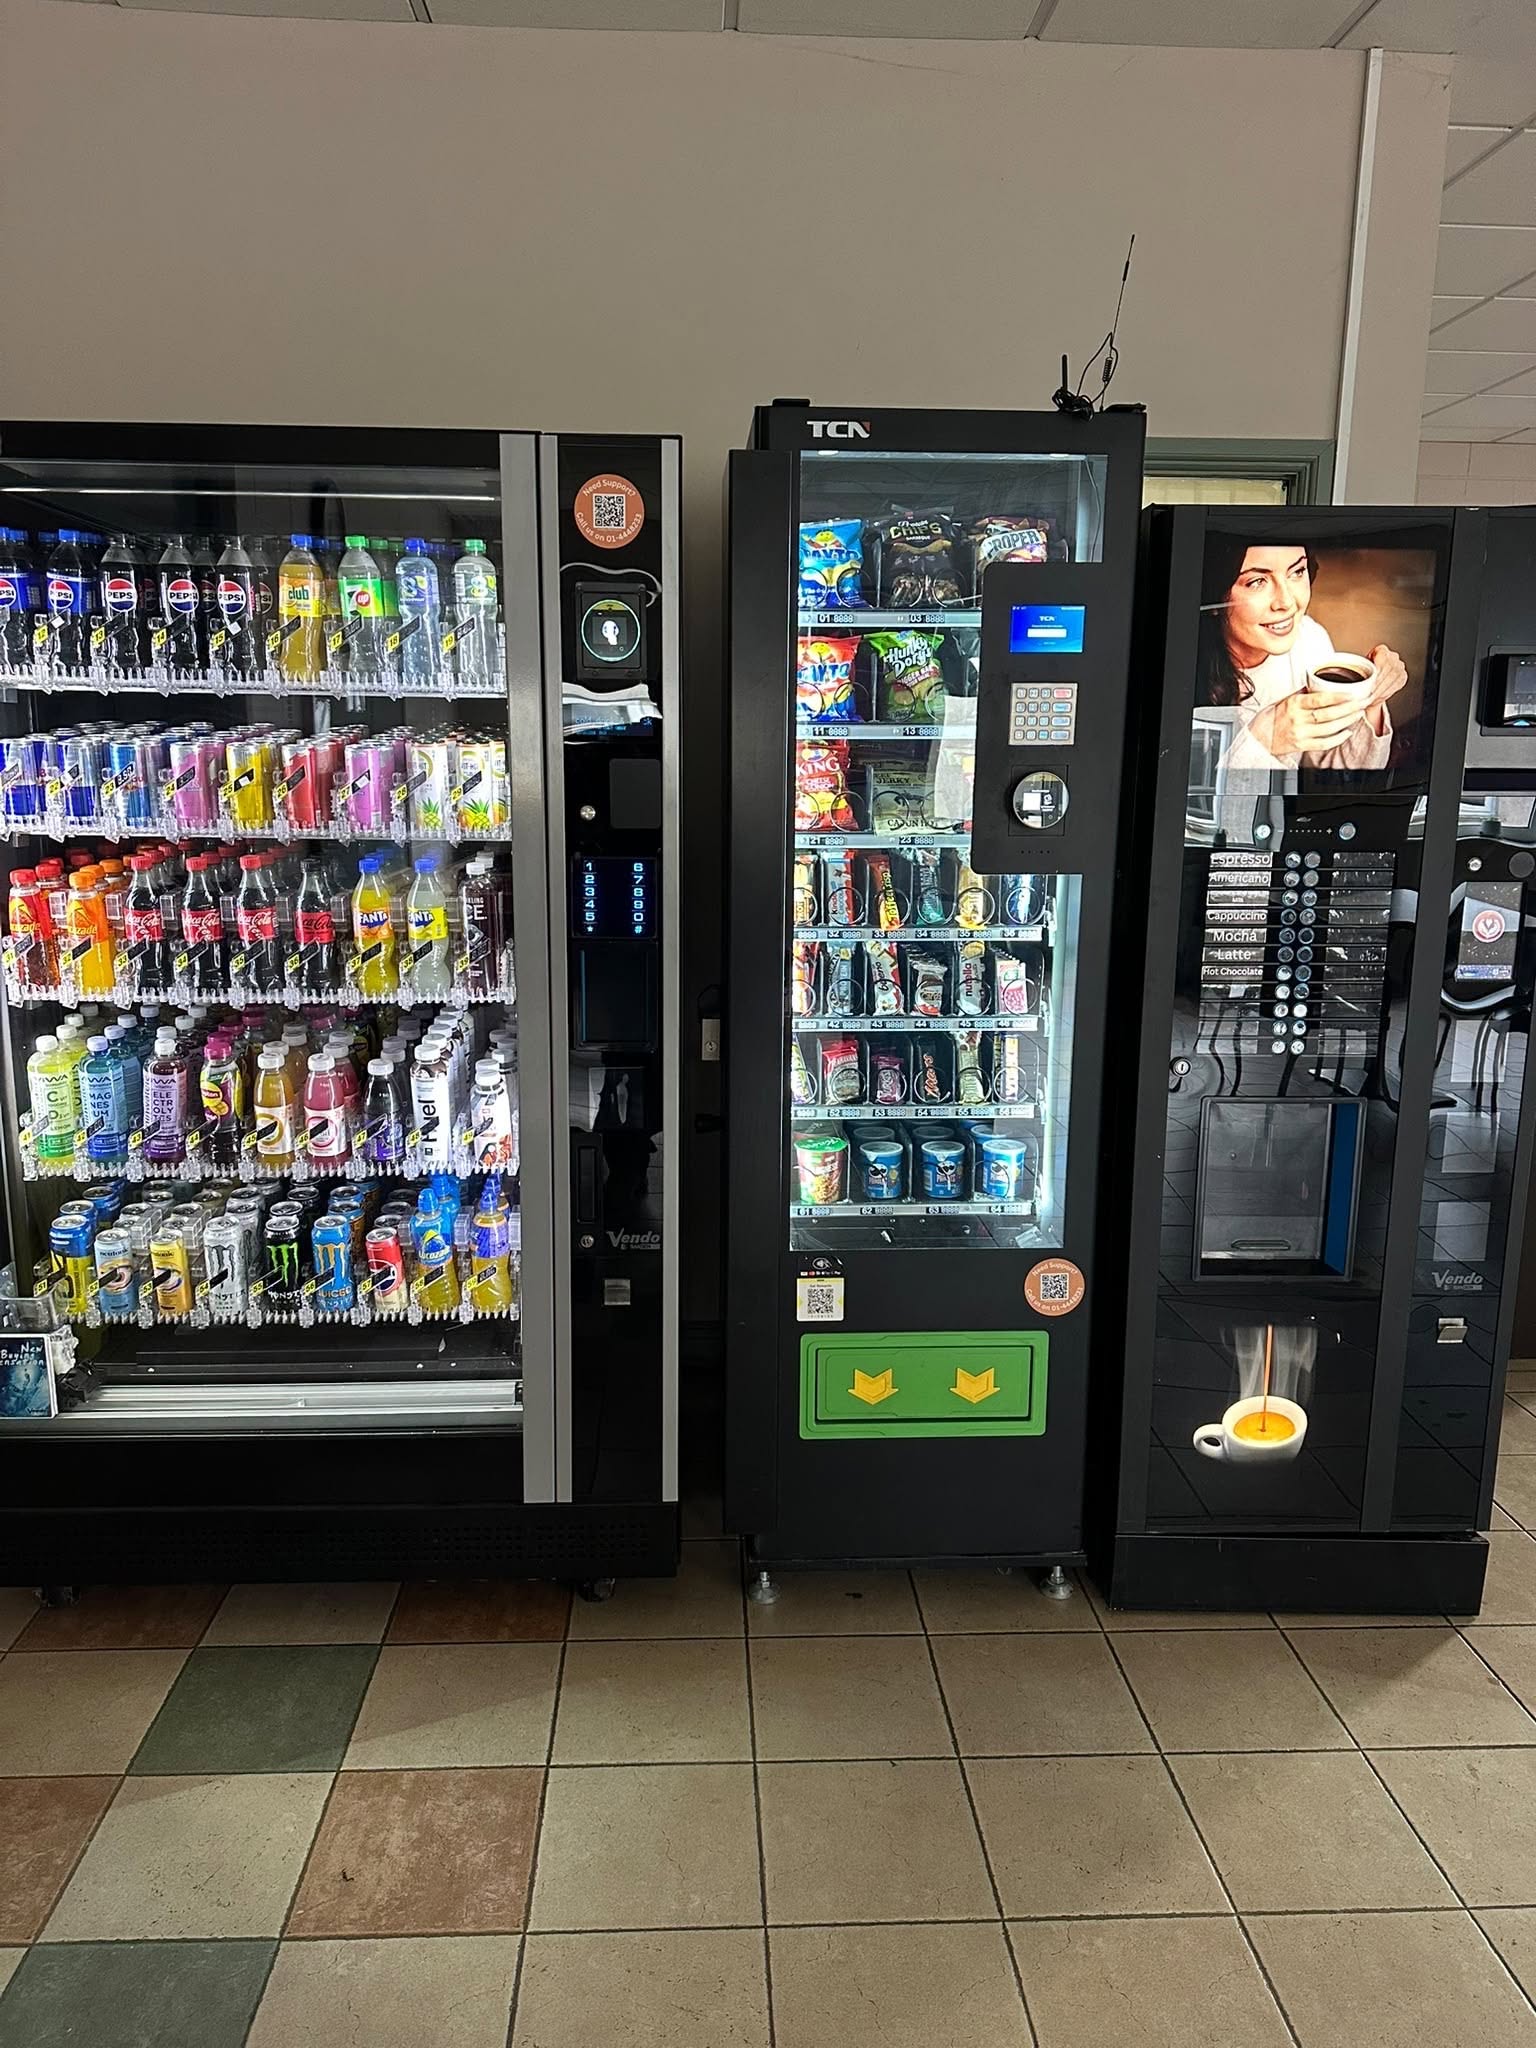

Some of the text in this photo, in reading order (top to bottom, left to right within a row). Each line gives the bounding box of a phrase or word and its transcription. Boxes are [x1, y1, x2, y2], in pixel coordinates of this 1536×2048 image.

[807, 421, 870, 438] TCN
[582, 479, 636, 497] Need Support?
[576, 512, 587, 529] Call
[586, 527, 595, 537] us
[595, 534, 605, 542] on
[890, 522, 942, 539] CHIPS
[50, 590, 72, 599] PPSI
[107, 591, 134, 600] PEPS
[169, 592, 198, 600] PEPSI
[218, 594, 244, 602] PEPSI
[289, 588, 309, 600] club
[357, 594, 369, 604] up
[819, 615, 830, 623] 01
[886, 637, 928, 662] Hunky
[815, 728, 825, 736] 11
[796, 757, 840, 777] KING
[1211, 854, 1270, 866] Espresso
[586, 862, 592, 871] 1
[634, 863, 643, 872] 6
[585, 875, 595, 884] 2
[633, 875, 643, 884] 7
[1209, 873, 1269, 884] Americano
[585, 888, 595, 896] 3
[634, 888, 643, 897] 8
[585, 900, 595, 908] 4
[634, 900, 643, 909] 9
[359, 911, 387, 924] FANTA
[585, 912, 595, 921] 5
[634, 913, 643, 921] 0
[1207, 912, 1267, 922] Cappuccino
[1217, 949, 1251, 960] Latte
[1203, 967, 1263, 976] Hot Chocolate
[963, 963, 973, 997] nutella
[828, 1020, 839, 1028] 42
[872, 1020, 883, 1028] 43
[915, 1020, 927, 1028] 44
[47, 1091, 58, 1102] C
[799, 1207, 809, 1215] 61
[606, 1227, 660, 1247] Vendo
[1032, 1263, 1048, 1276] Need
[1431, 1269, 1483, 1288] Vendo
[1027, 1288, 1036, 1301] Call
[21, 1342, 43, 1353] New
[1, 1350, 35, 1361] Buying
[0, 1358, 44, 1366] ensation
